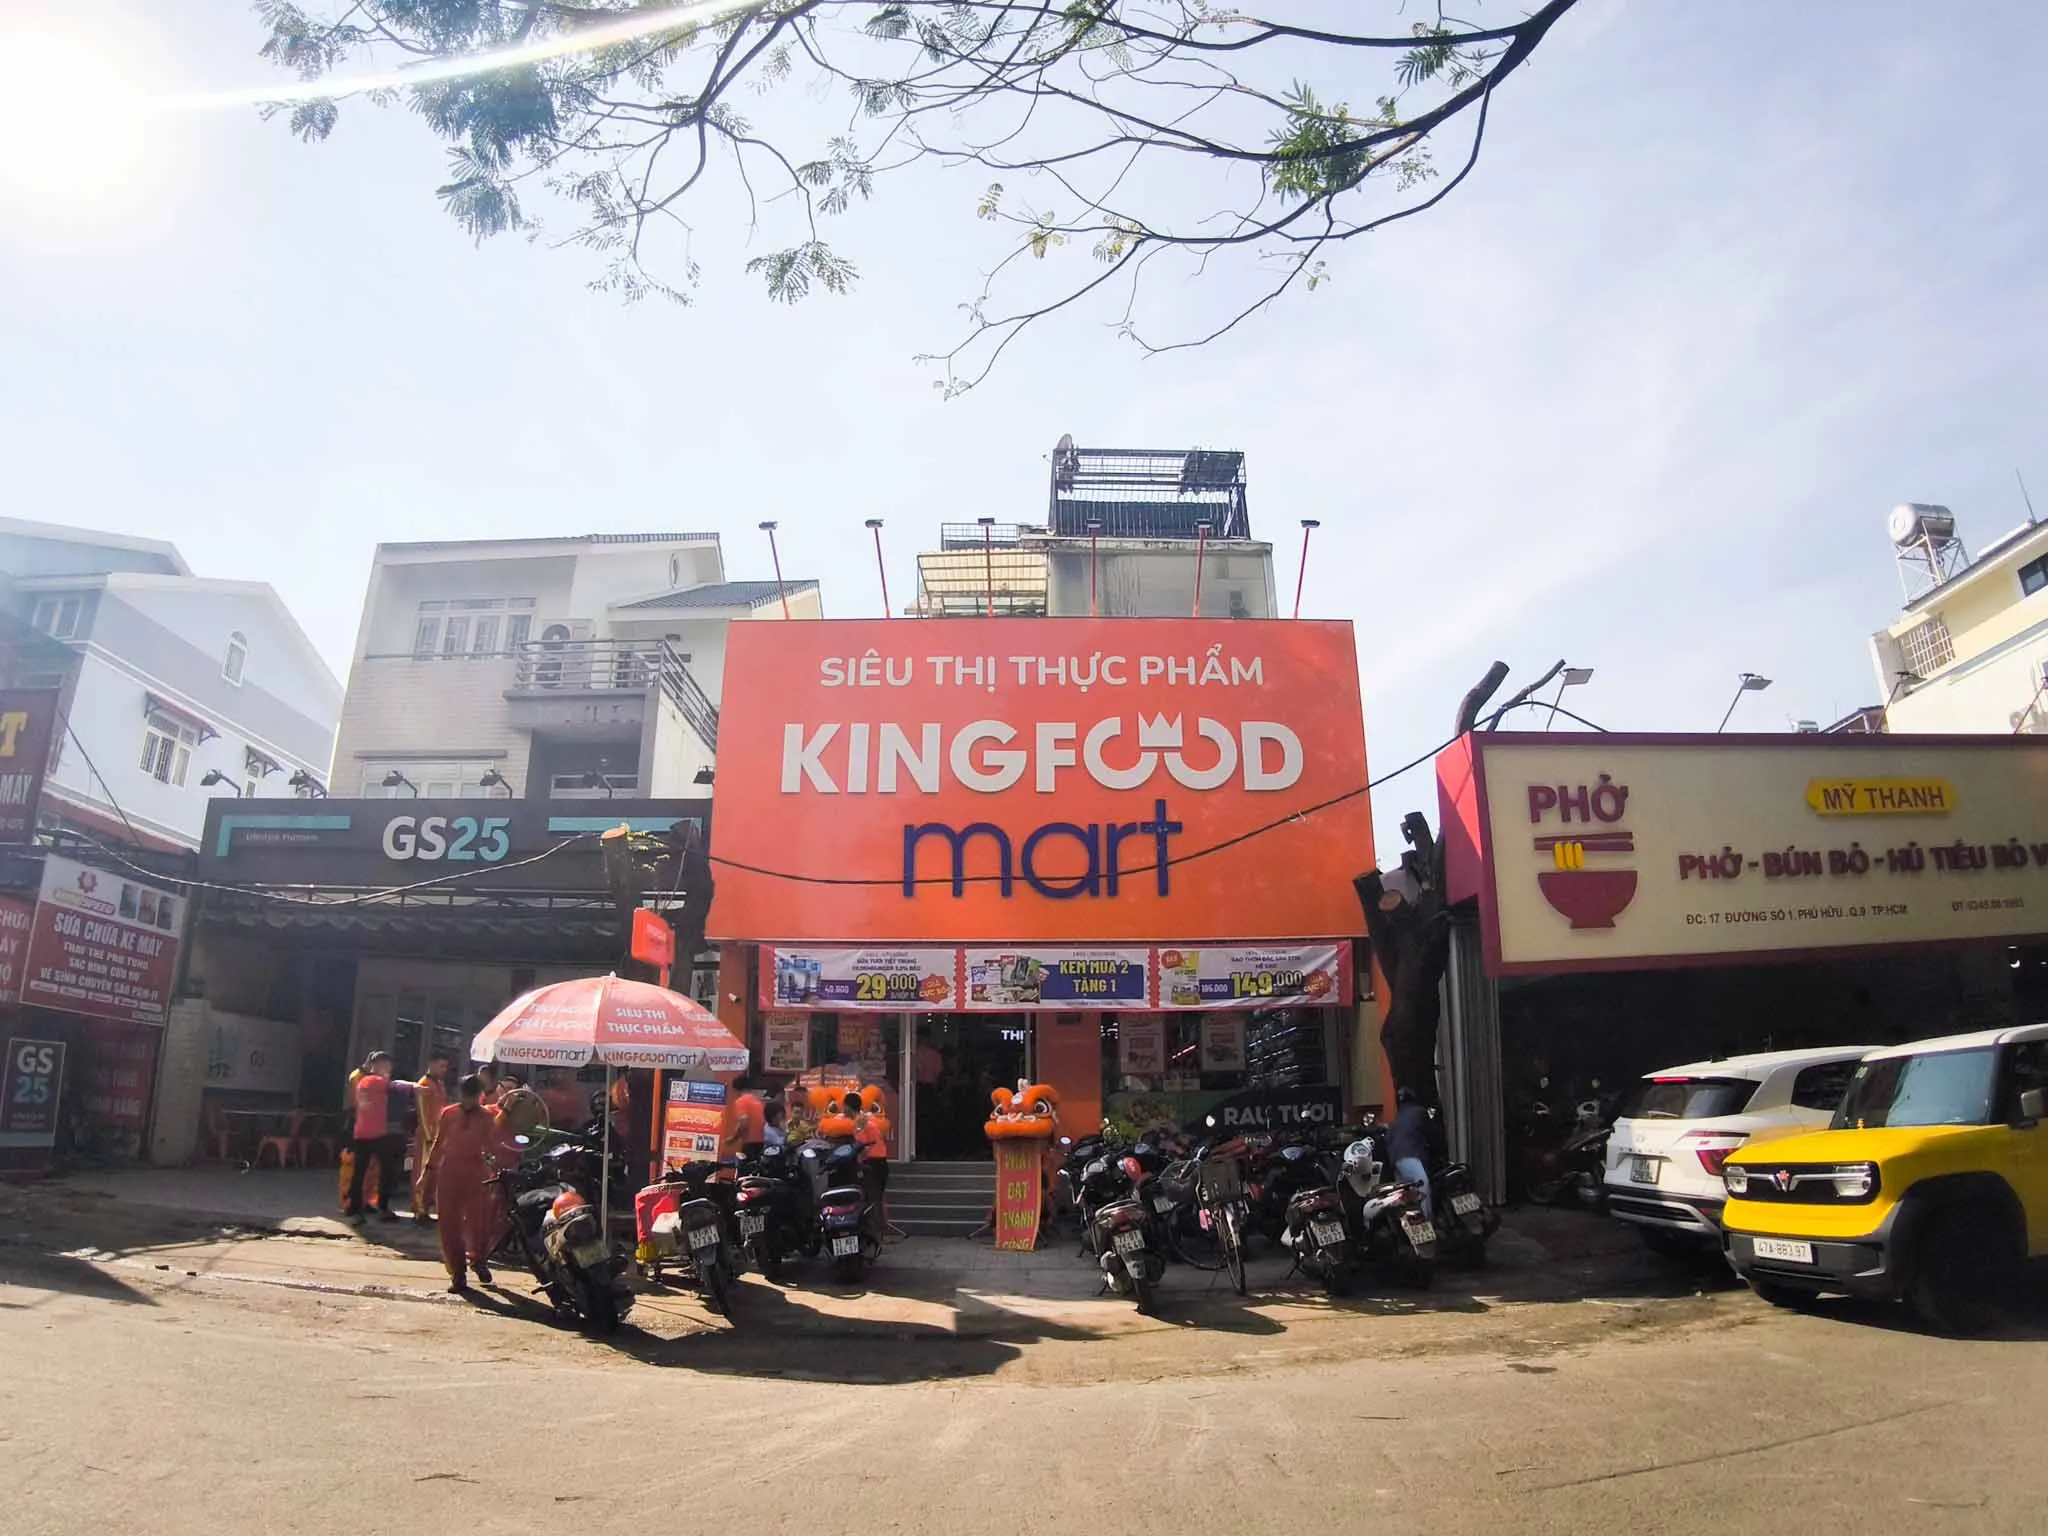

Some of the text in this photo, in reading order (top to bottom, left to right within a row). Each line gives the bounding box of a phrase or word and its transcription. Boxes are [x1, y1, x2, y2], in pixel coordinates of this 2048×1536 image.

[820, 643, 1265, 694] SIÊU THỊ THỰC PHẨM
[780, 713, 1304, 793] KINGFOOD
[1527, 773, 1629, 824] PHỞ
[1822, 782, 1945, 810] MỸ THANH
[382, 816, 511, 861] GS25
[903, 798, 1184, 899] mart
[1678, 846, 1743, 880] PHỞ
[1763, 846, 1822, 878] BÚN
[1828, 842, 1871, 876] BÒ
[1059, 960, 1129, 975] KEM MUA 2
[856, 972, 918, 1000] 29.000
[1073, 978, 1117, 997] TẶNG 1
[1230, 970, 1303, 998] 149.000
[17, 1045, 54, 1074] GS
[13, 1076, 50, 1104] 25
